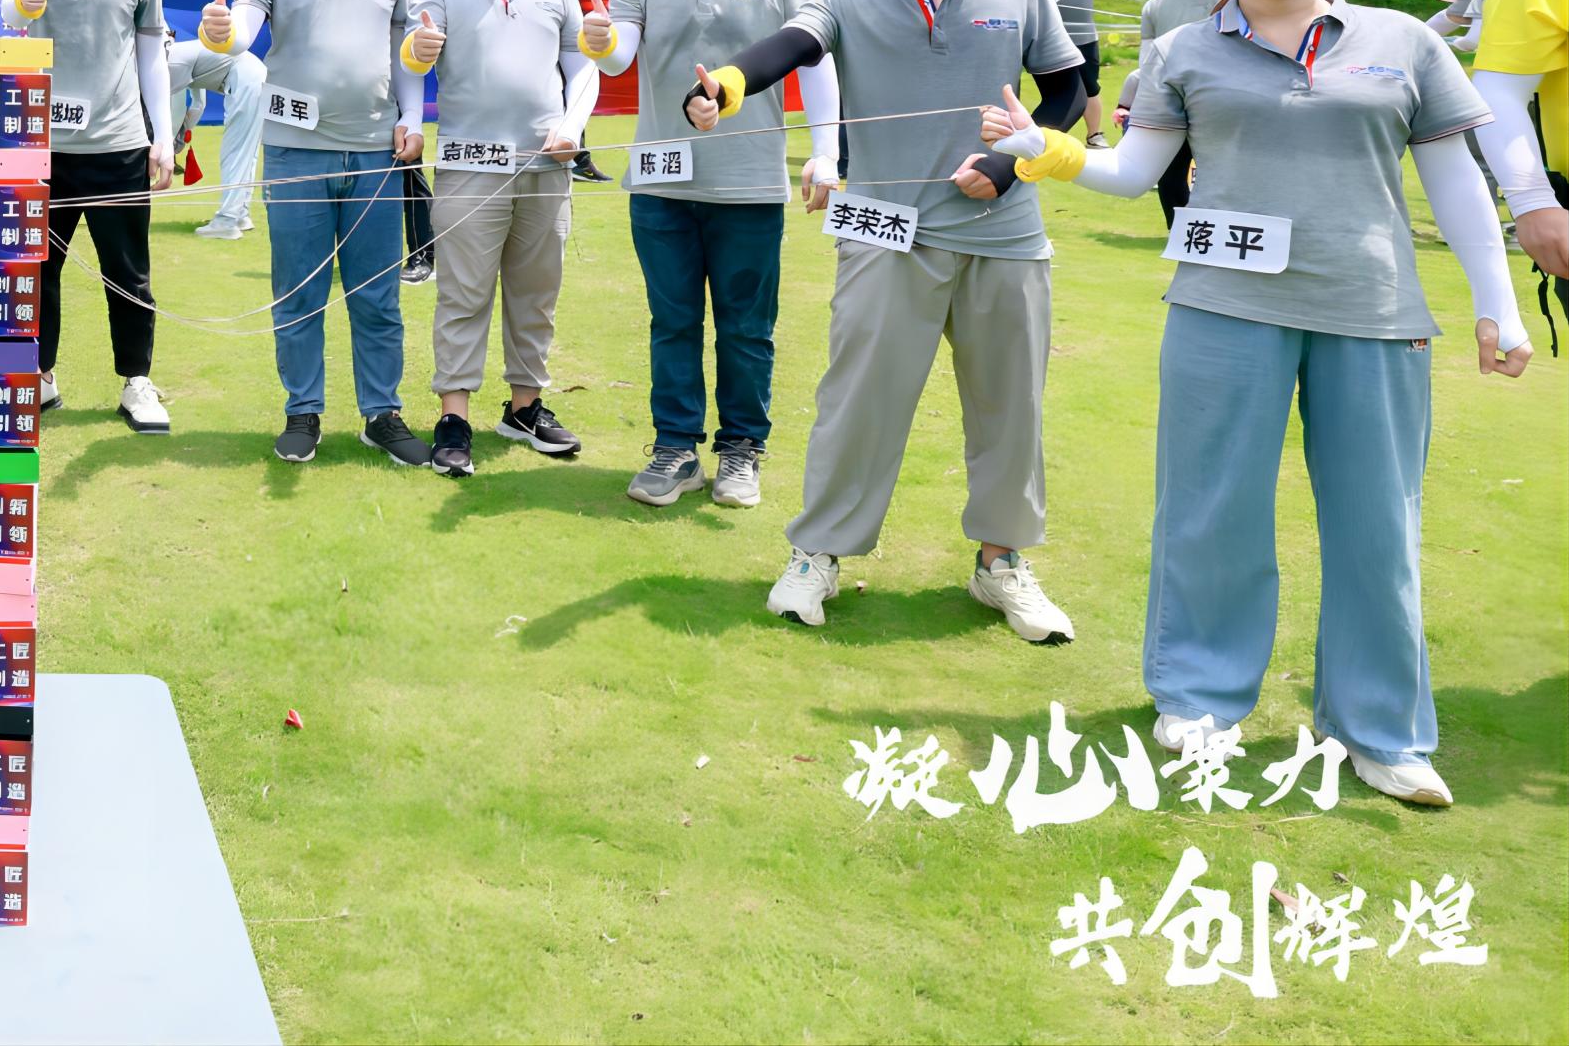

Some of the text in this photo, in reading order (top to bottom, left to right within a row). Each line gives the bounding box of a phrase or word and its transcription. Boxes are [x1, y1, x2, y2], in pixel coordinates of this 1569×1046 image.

[4, 89, 45, 106] 工匠
[2, 200, 43, 217] 工匠
[830, 202, 910, 244] 李荣杰
[1184, 219, 1264, 260] 蒋平
